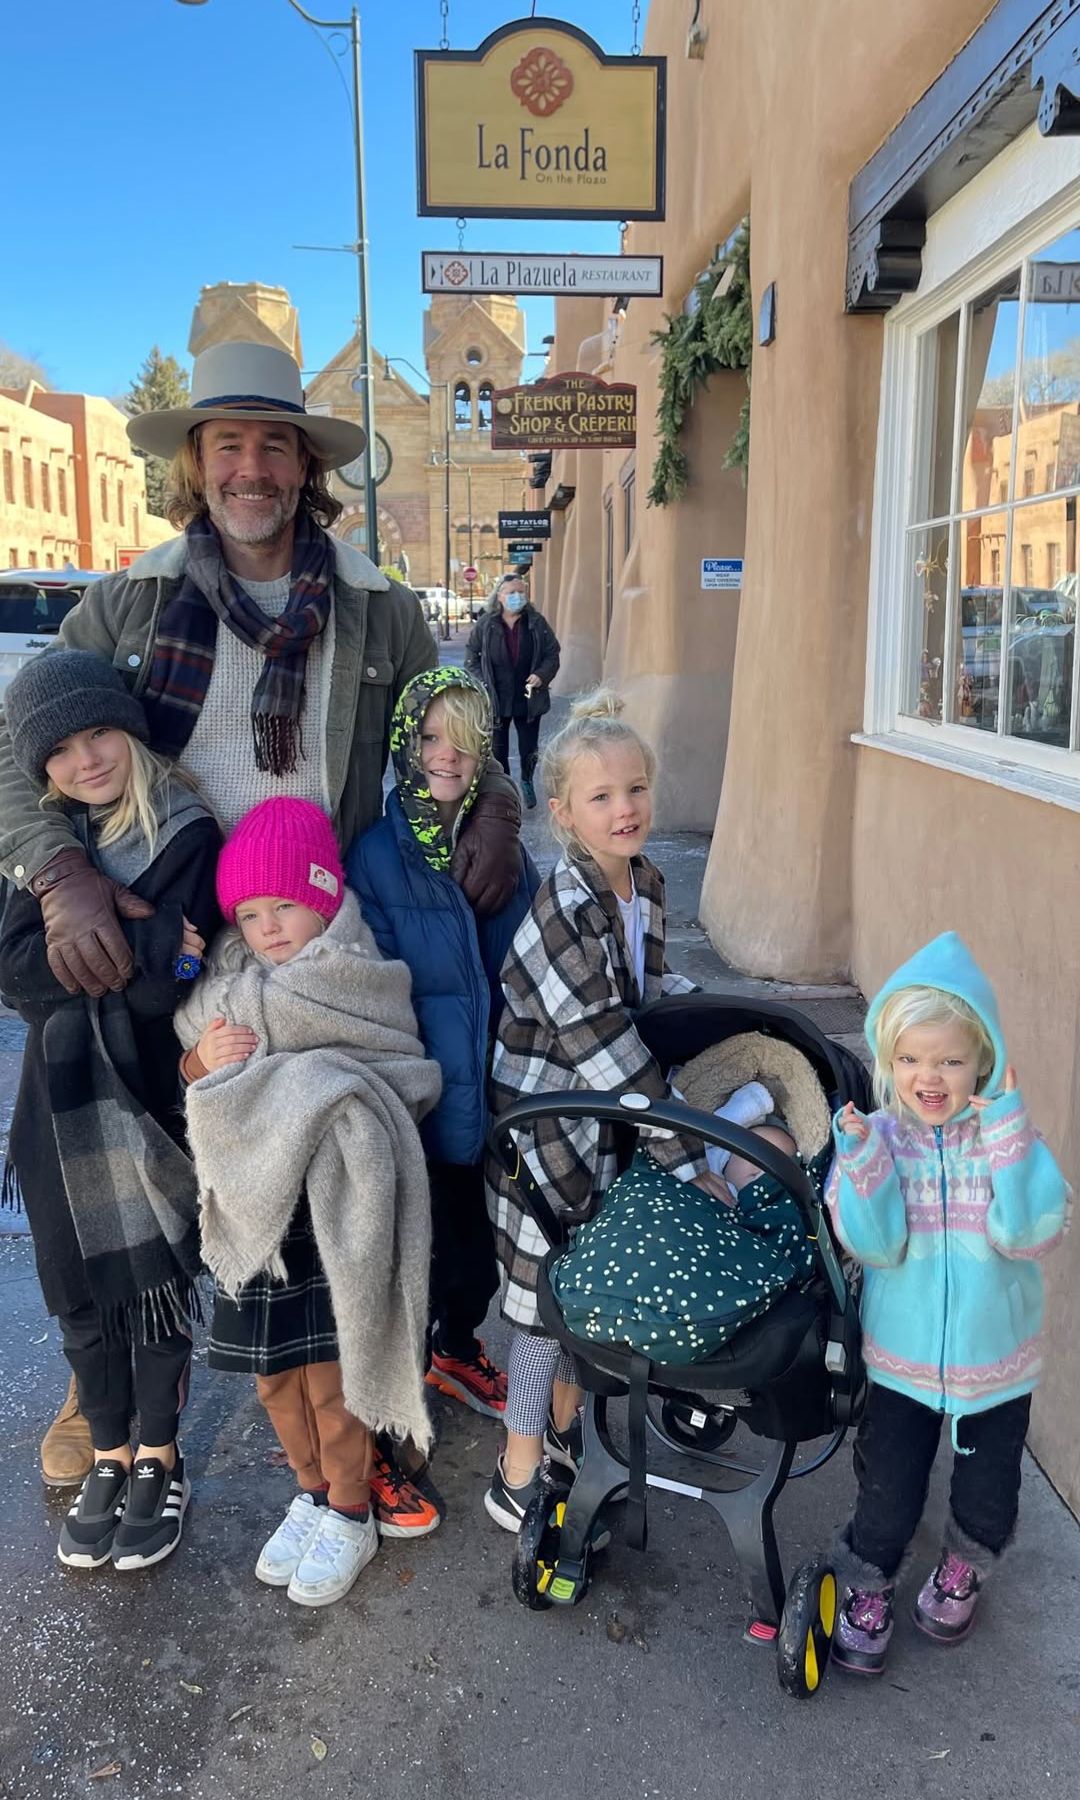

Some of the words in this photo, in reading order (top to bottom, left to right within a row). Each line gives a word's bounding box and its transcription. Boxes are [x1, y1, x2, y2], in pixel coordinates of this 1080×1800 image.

[477, 124, 509, 169] La
[520, 127, 607, 181] Fonda
[535, 173, 553, 184] On
[557, 173, 573, 184] the
[577, 174, 607, 185] Plaza
[480, 260, 499, 286] La
[507, 260, 577, 287] Plazuela
[581, 269, 652, 281] RESTAURANT
[565, 380, 585, 389] THE
[514, 392, 571, 413] FRENCH
[577, 391, 634, 413] PASTRY
[510, 414, 551, 435] SHOP
[554, 416, 566, 432] &
[501, 519, 518, 527] TOM
[520, 519, 549, 527] TAYLOR
